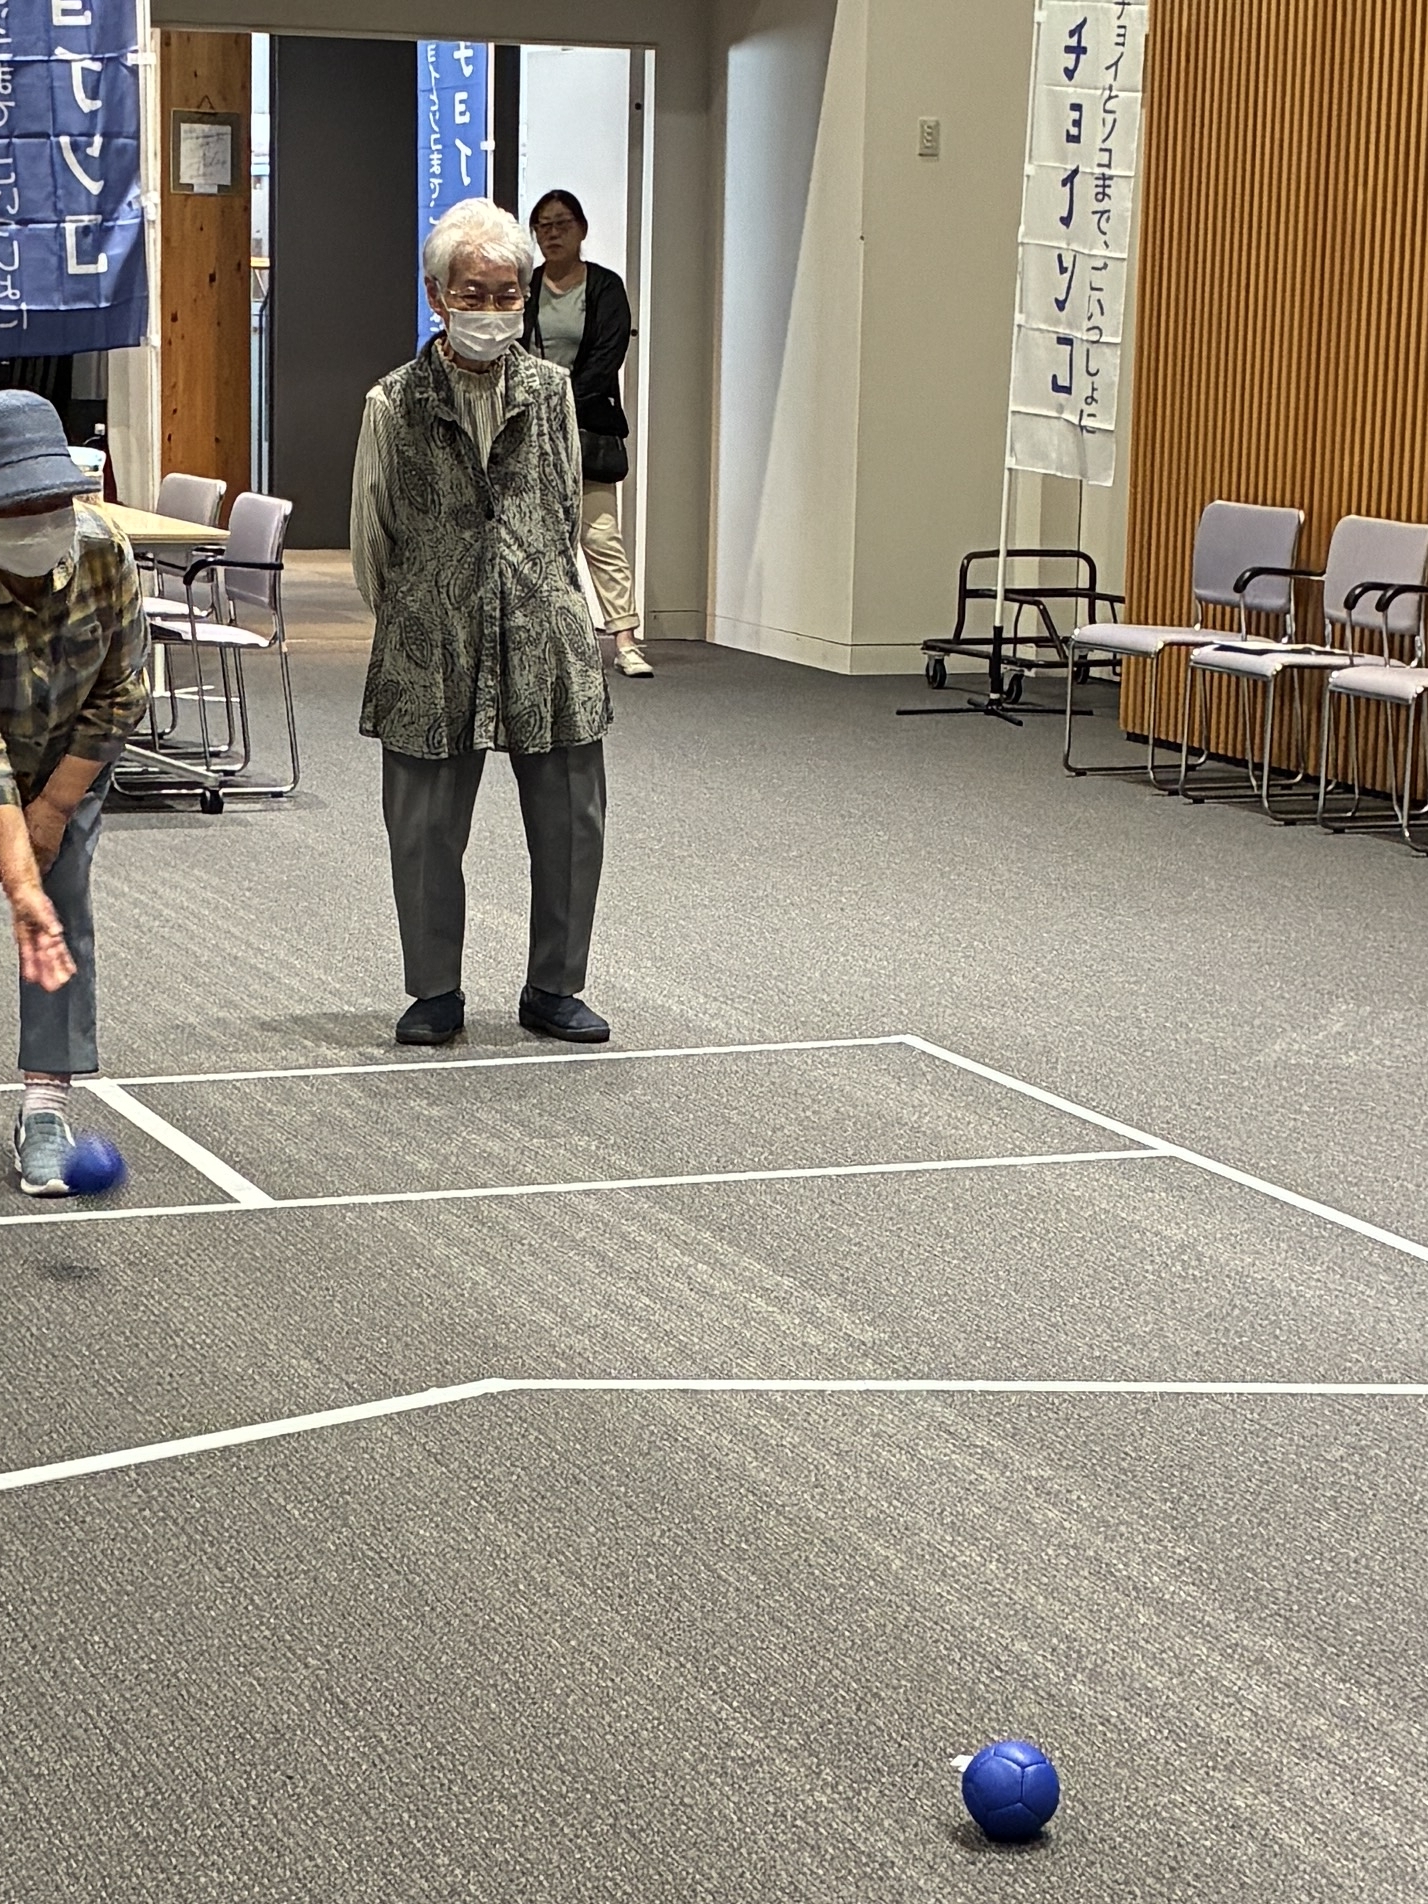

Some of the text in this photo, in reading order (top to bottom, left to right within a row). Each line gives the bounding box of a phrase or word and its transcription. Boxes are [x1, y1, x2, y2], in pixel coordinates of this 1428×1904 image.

[1051, 15, 1086, 396] チョイソコ
